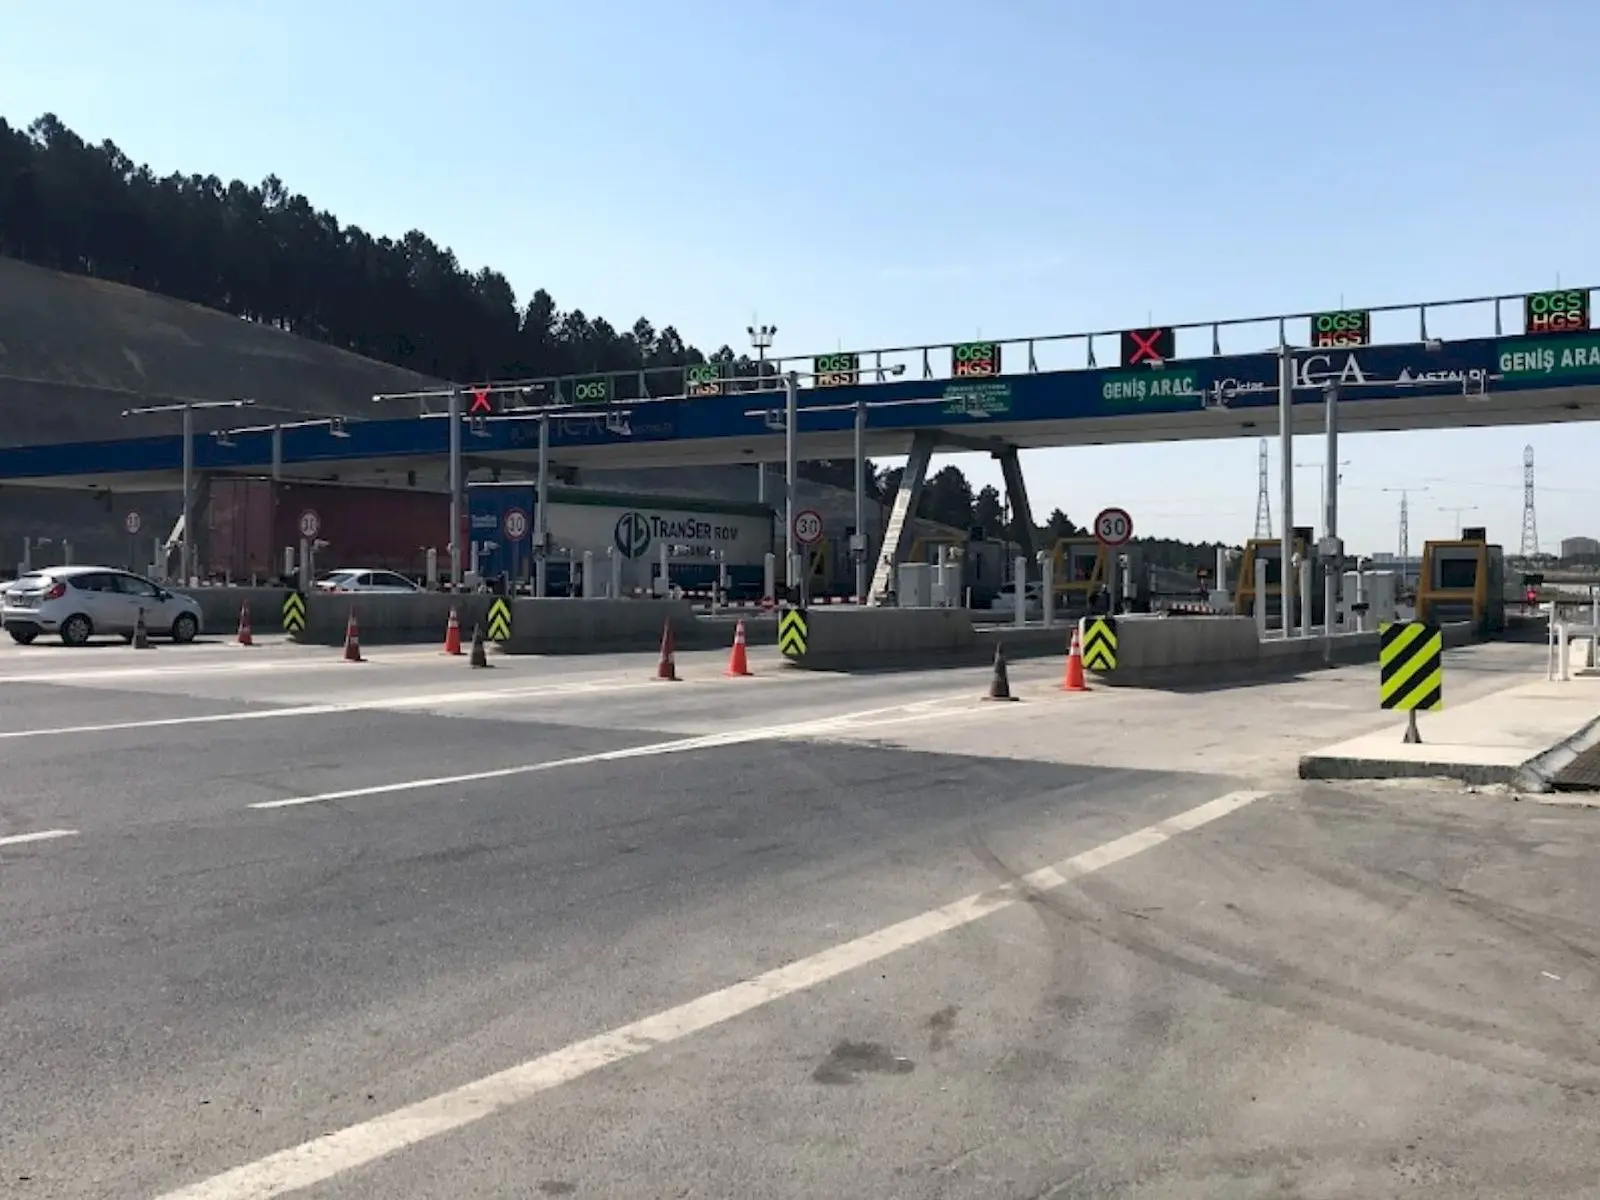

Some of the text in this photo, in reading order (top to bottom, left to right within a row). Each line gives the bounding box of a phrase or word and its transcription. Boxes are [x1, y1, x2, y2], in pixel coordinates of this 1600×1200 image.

[1530, 293, 1582, 313] OGS
[1317, 312, 1362, 332] OGS
[1532, 310, 1582, 330] HGS
[1318, 330, 1362, 347] HGS
[956, 344, 993, 360] OGS
[1501, 347, 1555, 373] GENİŞ
[818, 354, 850, 371] OGS
[957, 359, 993, 376] HGS
[689, 365, 720, 382] OGS
[575, 382, 606, 399] OGS
[799, 518, 818, 534] 30
[1101, 517, 1126, 537] 30
